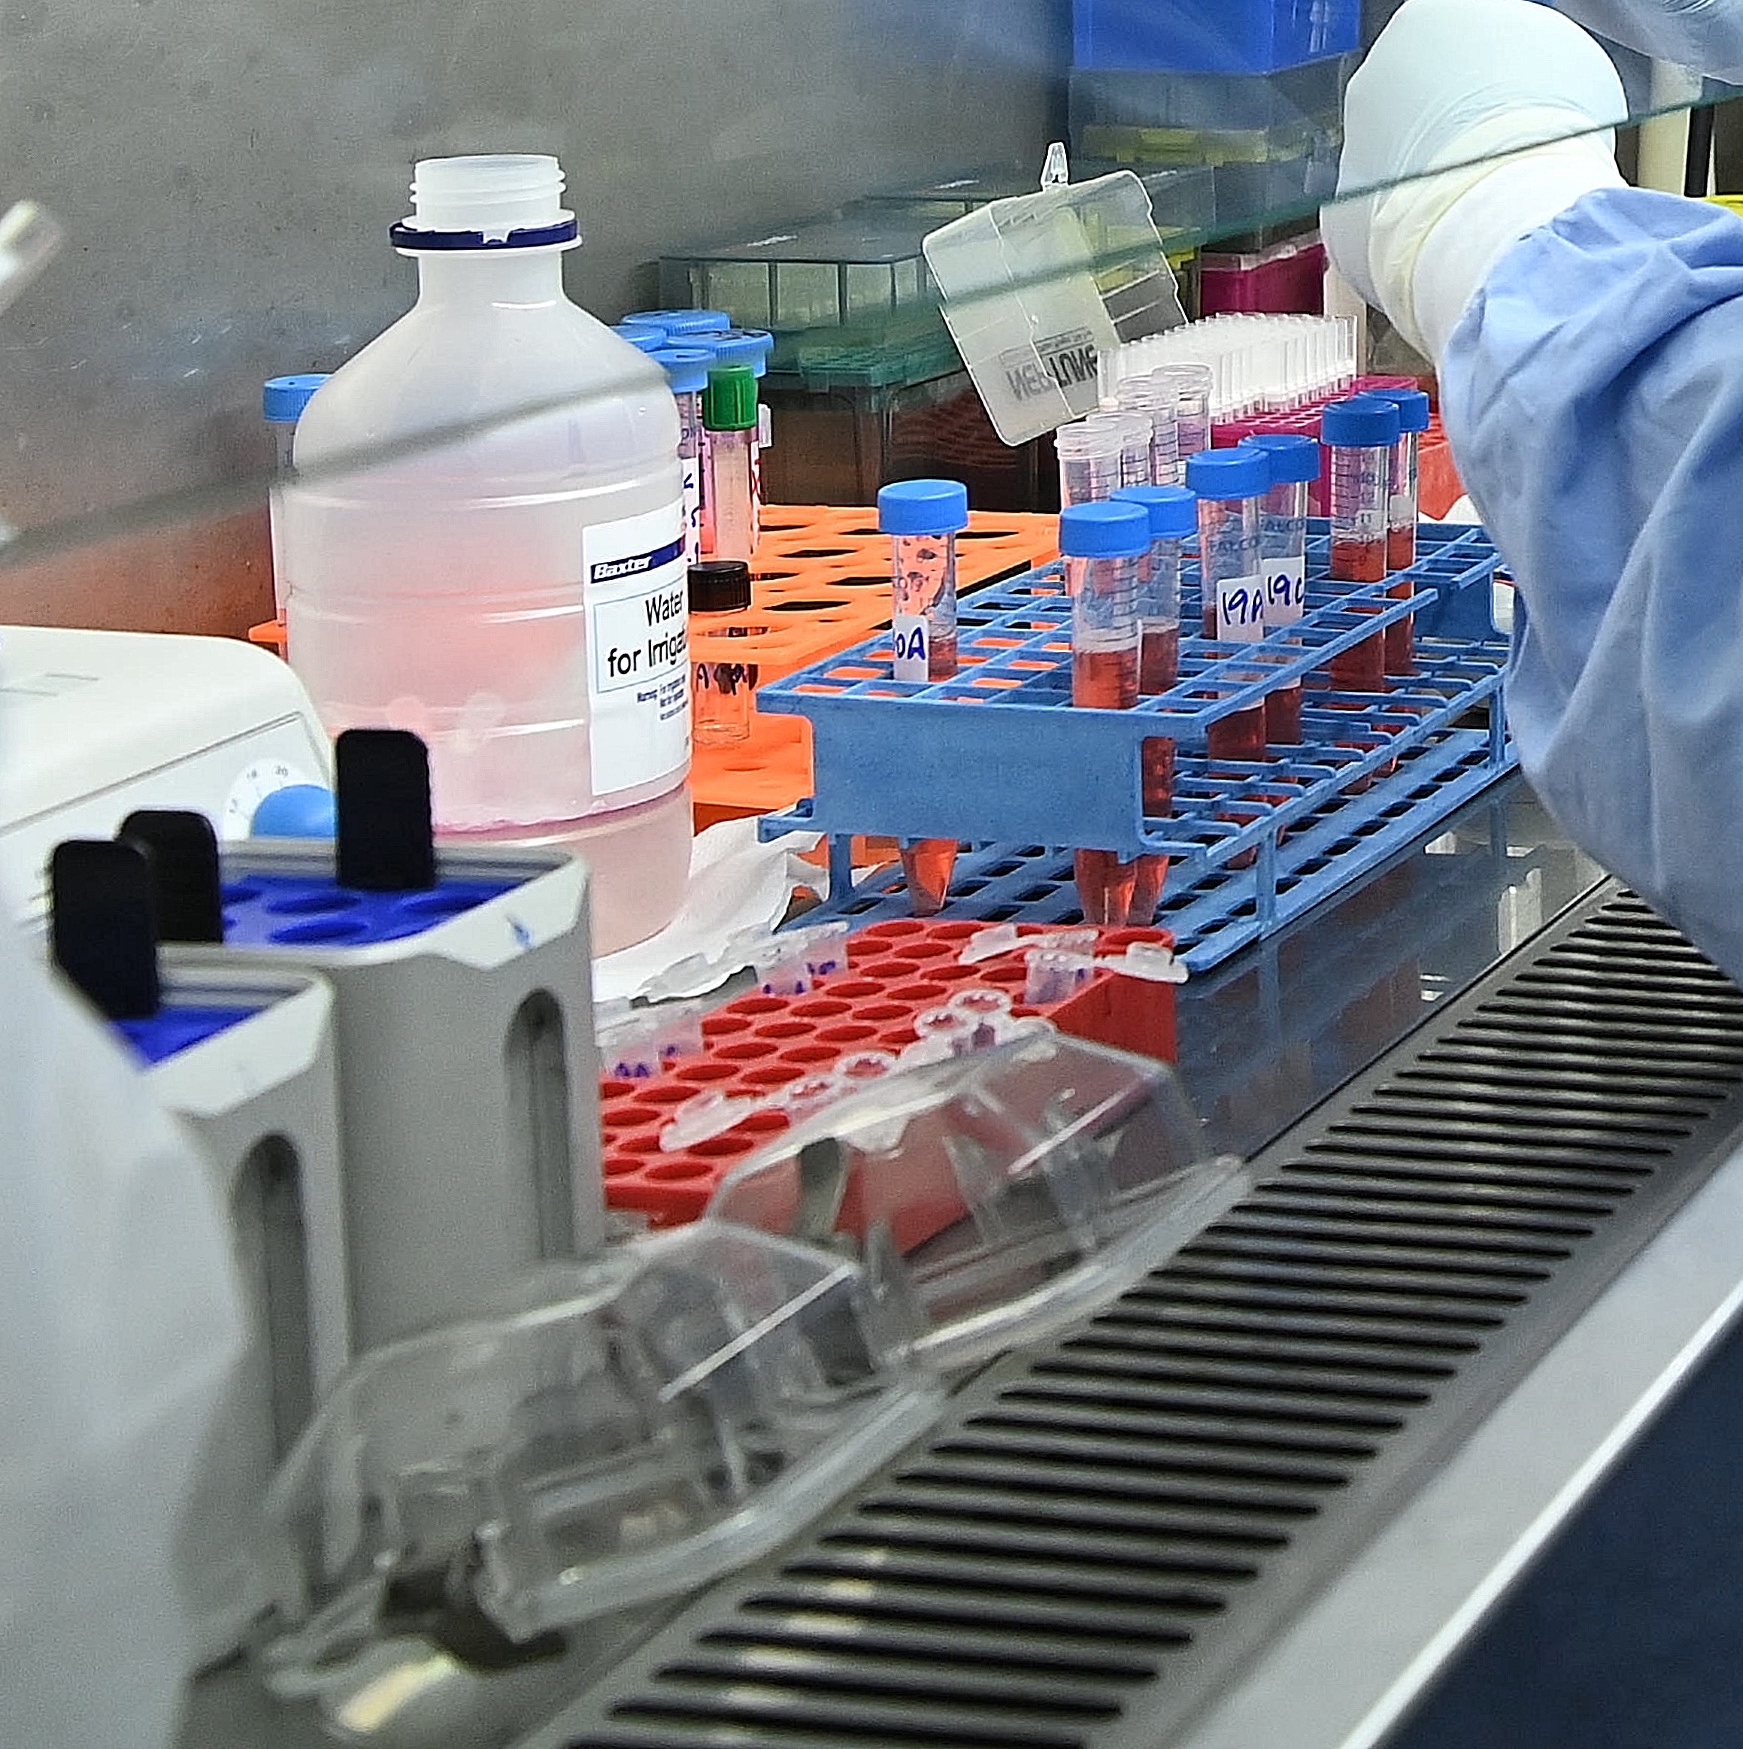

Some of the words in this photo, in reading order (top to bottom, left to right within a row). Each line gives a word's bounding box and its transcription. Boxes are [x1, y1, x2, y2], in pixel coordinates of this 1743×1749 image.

[593, 555, 653, 581] Baxter
[645, 590, 684, 627] Water
[607, 647, 642, 678] for
